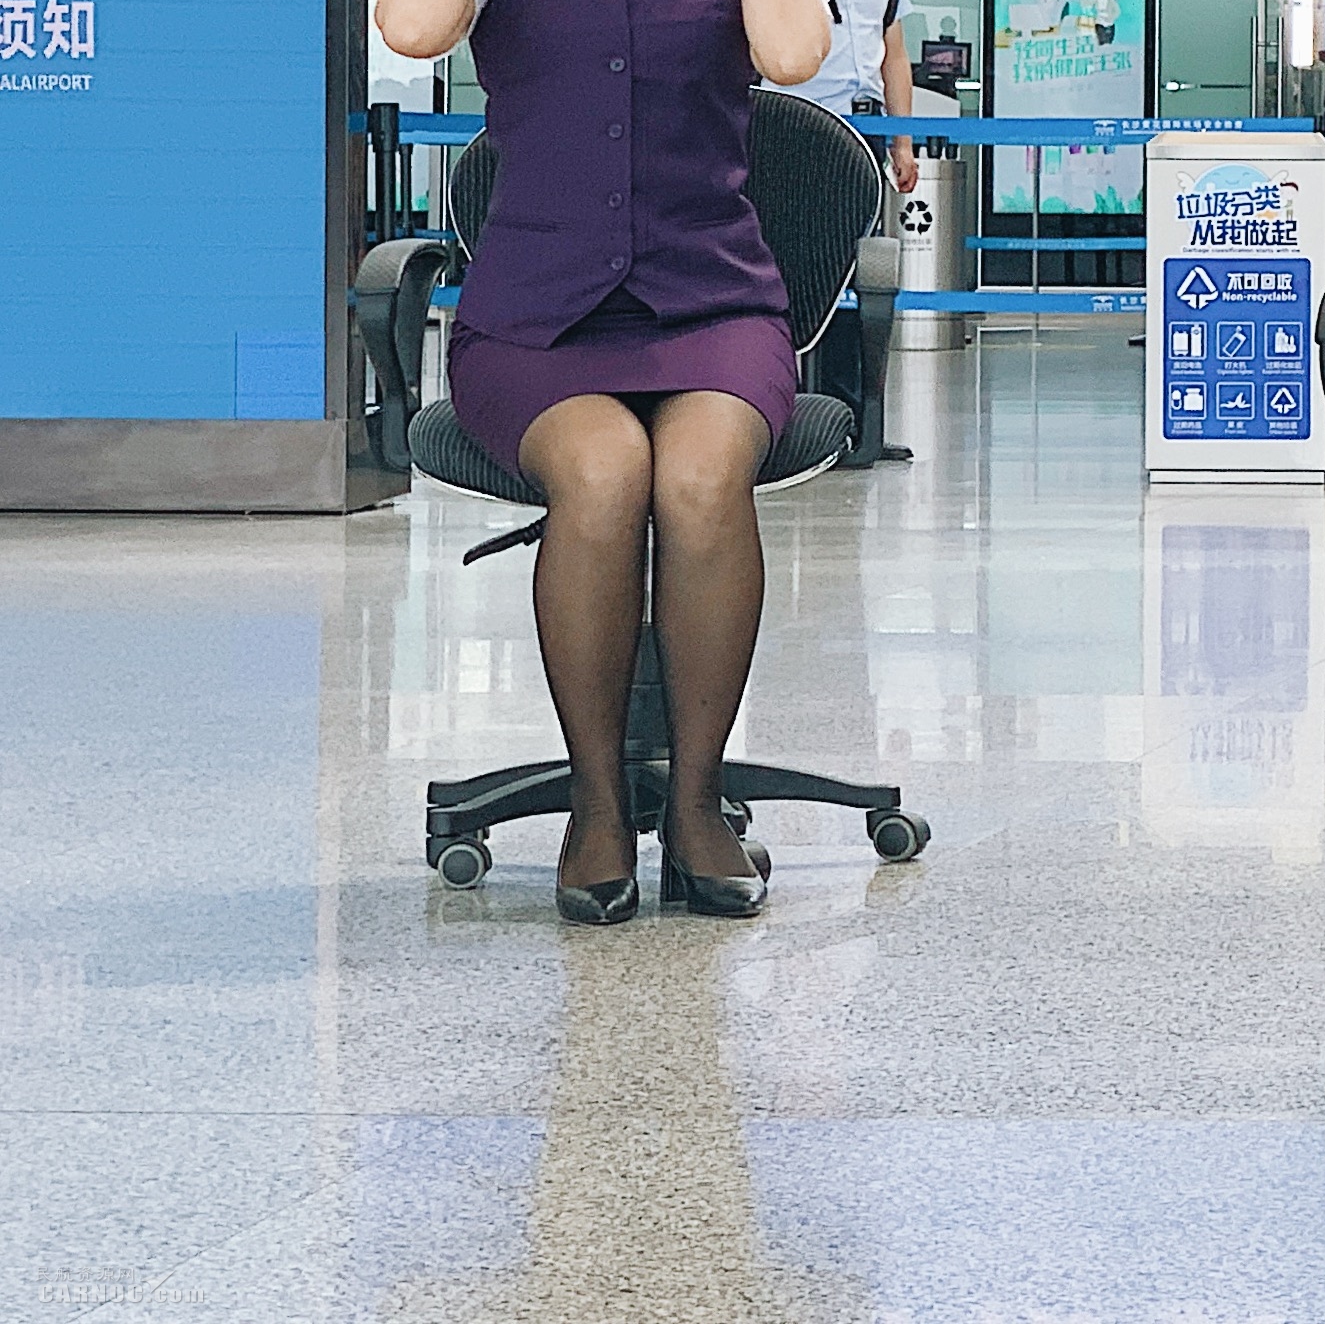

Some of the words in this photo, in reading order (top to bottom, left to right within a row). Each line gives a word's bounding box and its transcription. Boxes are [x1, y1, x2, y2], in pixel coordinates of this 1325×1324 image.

[0, 74, 93, 91] ALAIRPORT
[1177, 185, 1280, 219] 垃圾分类
[1190, 219, 1298, 246] 从我做起
[1227, 272, 1293, 290] 不可回收
[1221, 291, 1298, 304] Non-recyclable
